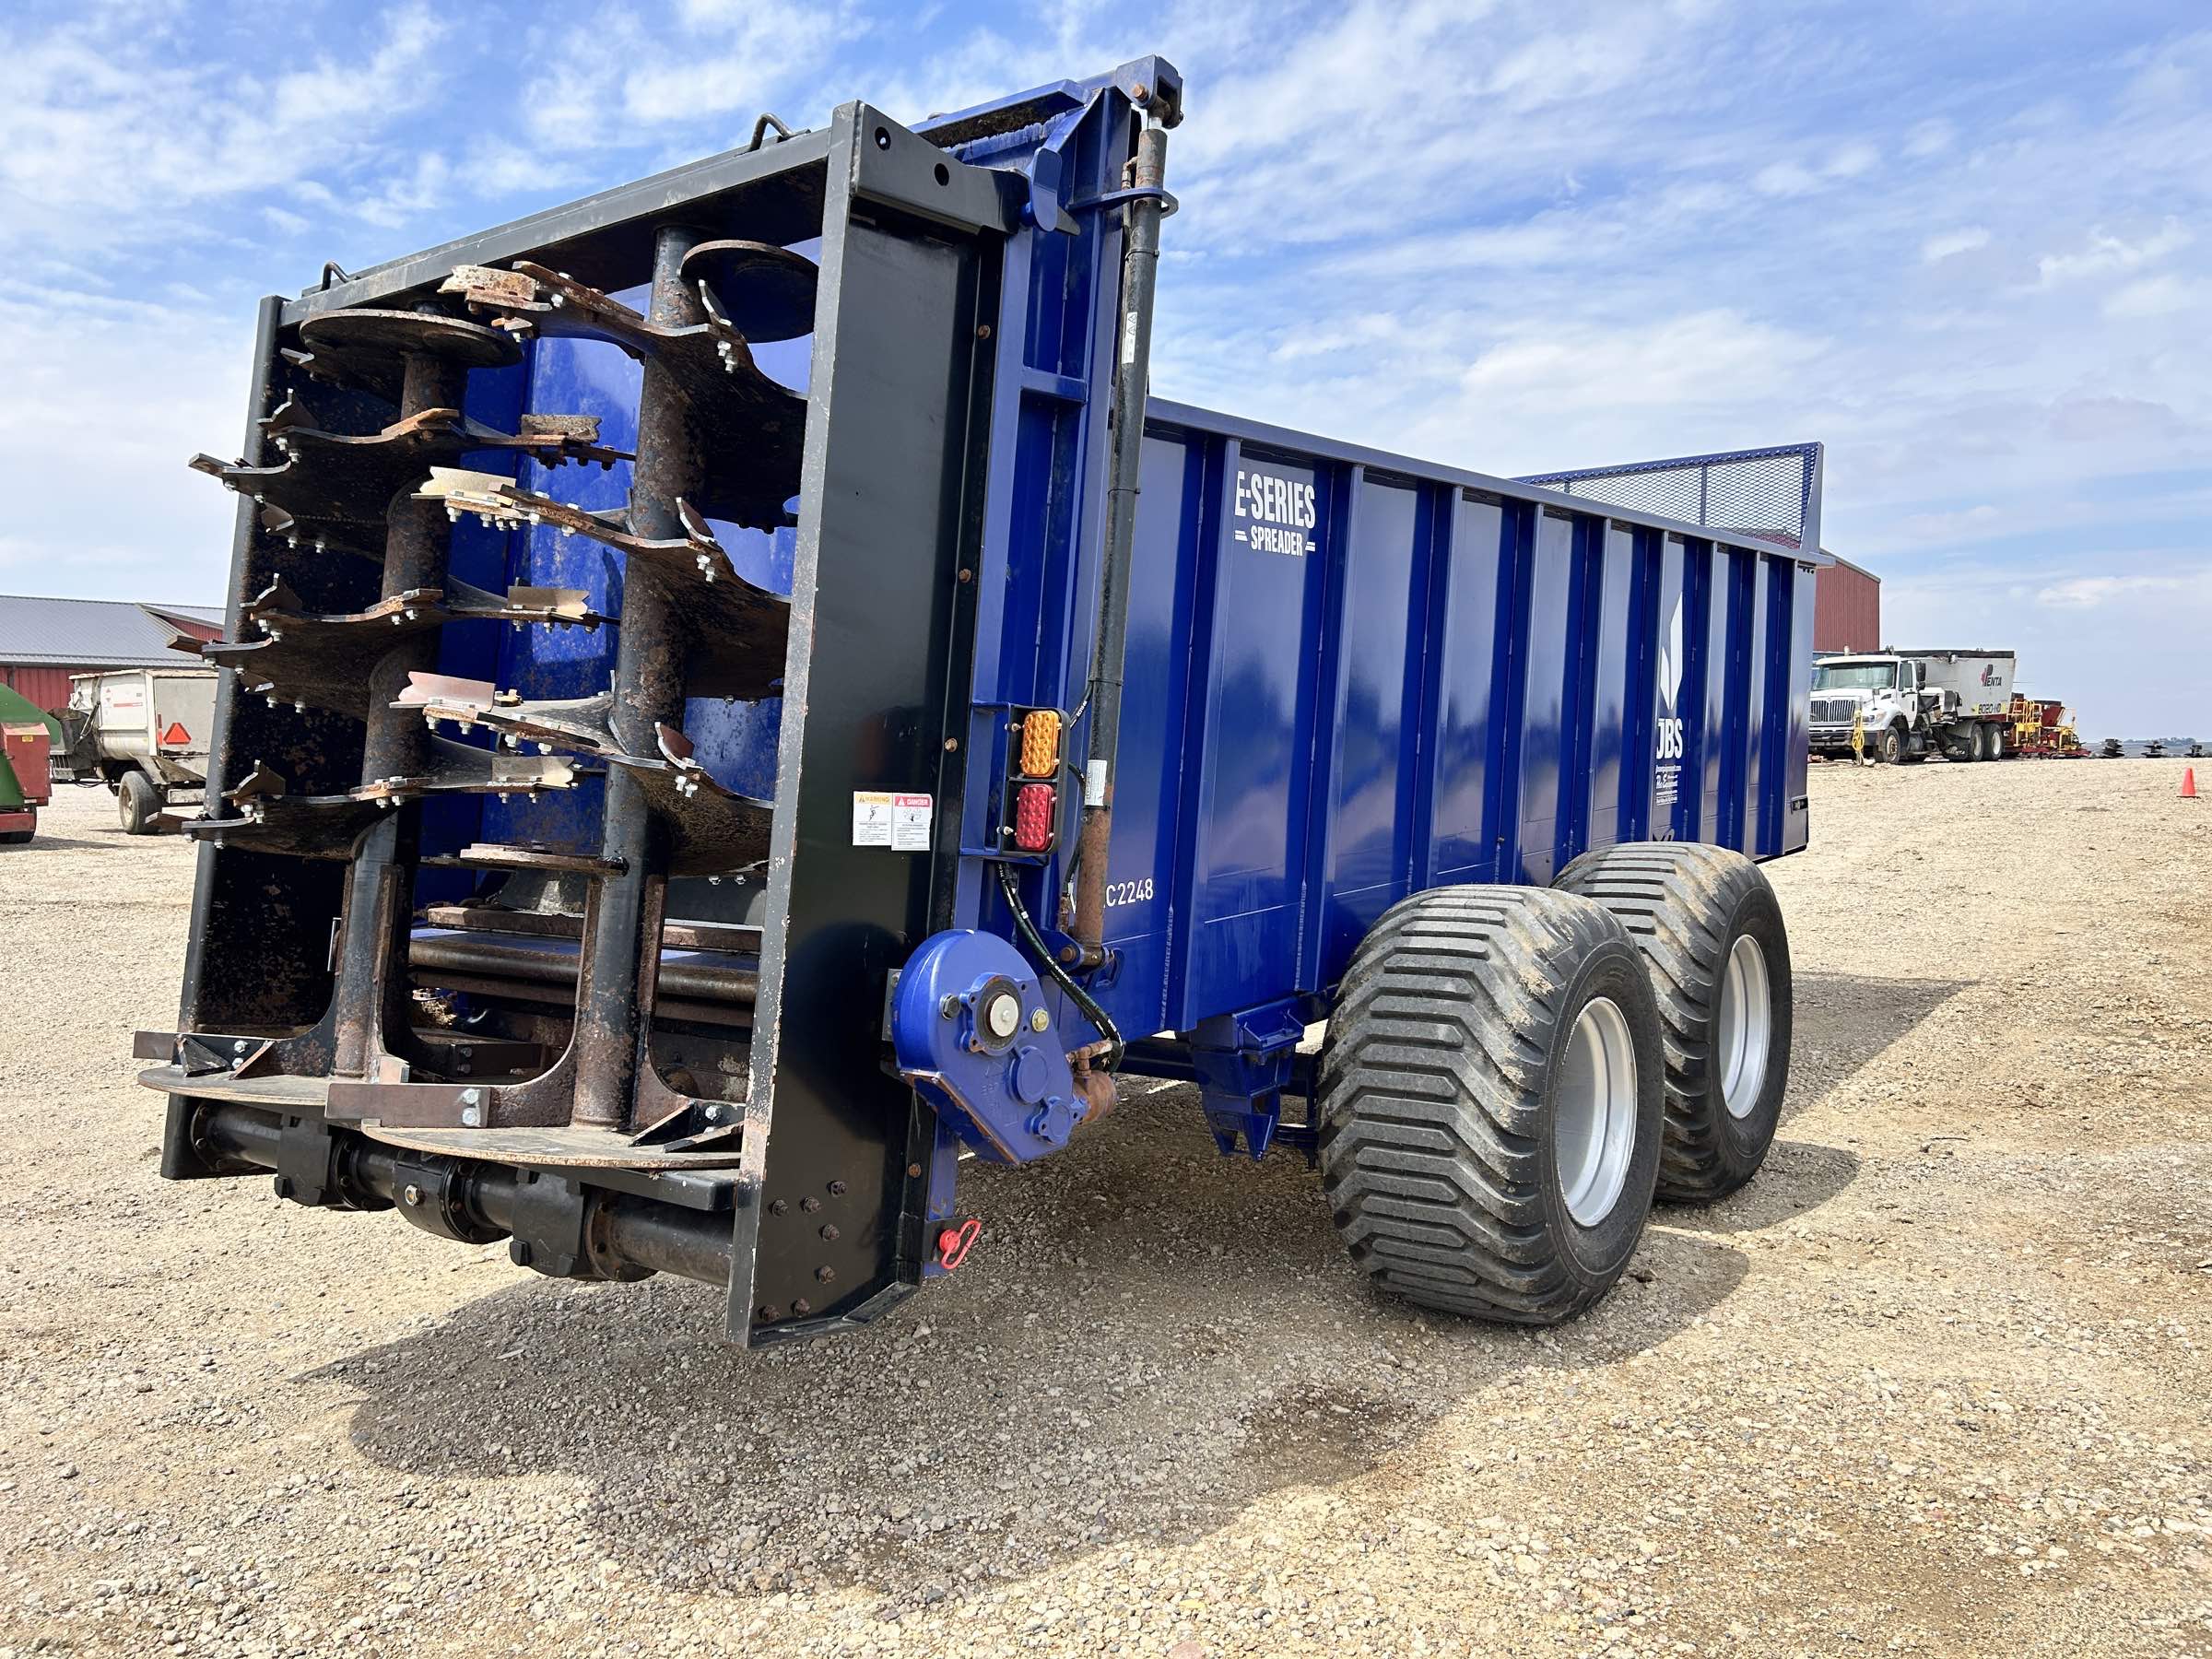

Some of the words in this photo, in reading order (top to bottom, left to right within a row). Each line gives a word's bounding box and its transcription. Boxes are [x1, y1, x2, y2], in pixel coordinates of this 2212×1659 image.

[1234, 470, 1316, 529] E-SERIES
[1250, 524, 1303, 557] SPREADER
[1982, 664, 2003, 687] PENTA
[1655, 717, 1684, 759] JBS
[1102, 877, 1154, 908] C2248
